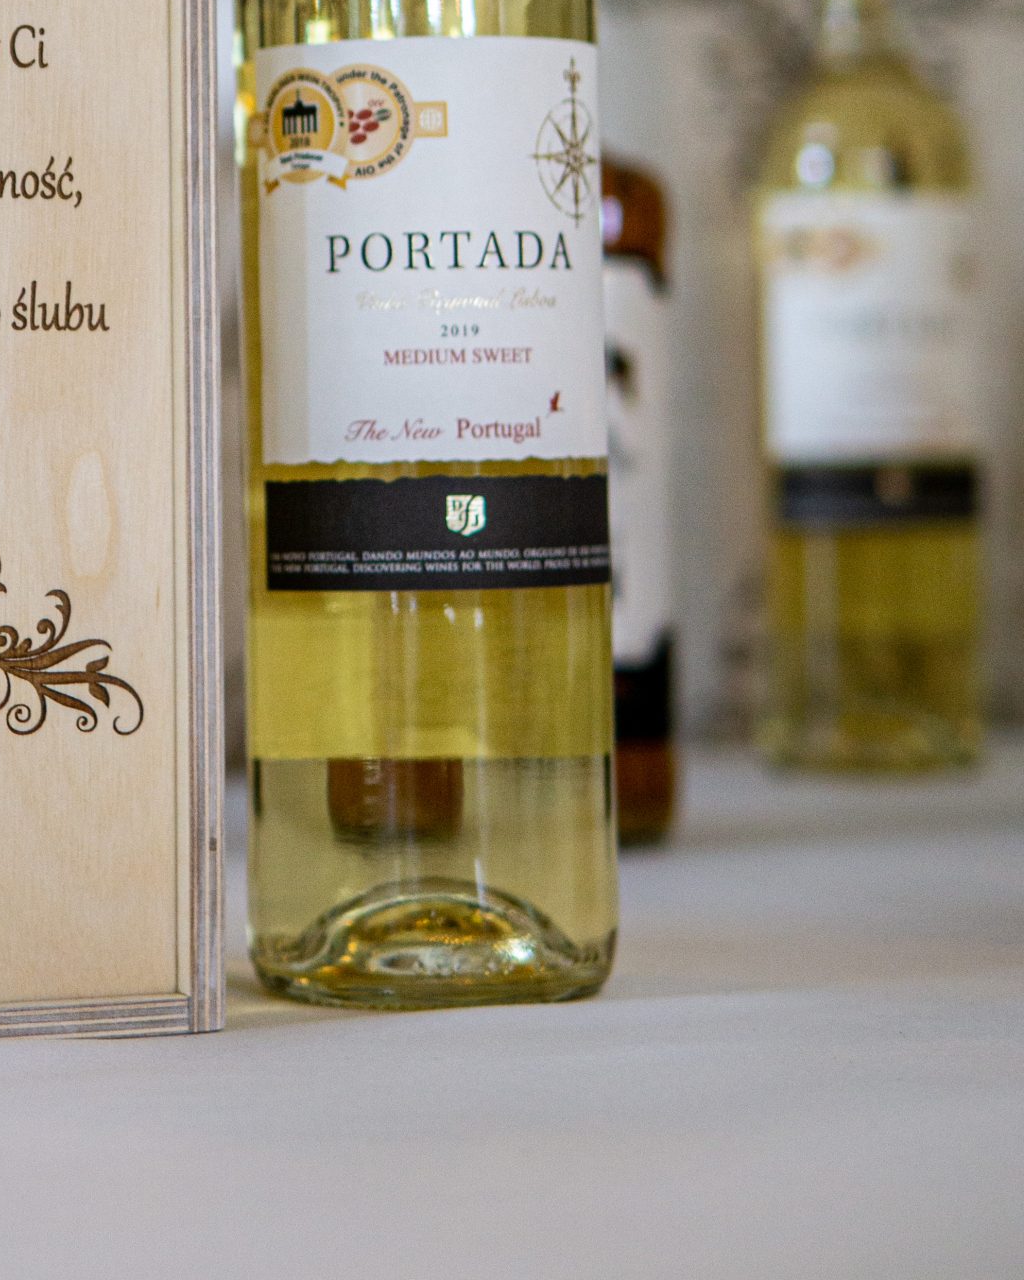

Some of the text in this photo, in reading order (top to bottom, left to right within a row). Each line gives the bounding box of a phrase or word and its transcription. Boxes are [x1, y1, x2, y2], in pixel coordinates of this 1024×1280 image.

[9, 23, 50, 70] Ci
[370, 71, 388, 85] the
[326, 231, 573, 274] PORTADA
[11, 279, 111, 333] ślubu
[440, 324, 480, 338] 2019
[383, 347, 533, 367] MEDIUM SWEET
[344, 416, 542, 444] The New Portugal
[362, 549, 403, 562] DANDO
[406, 548, 457, 562] MUNDOS
[459, 549, 475, 561] AO
[424, 561, 458, 573] WINES
